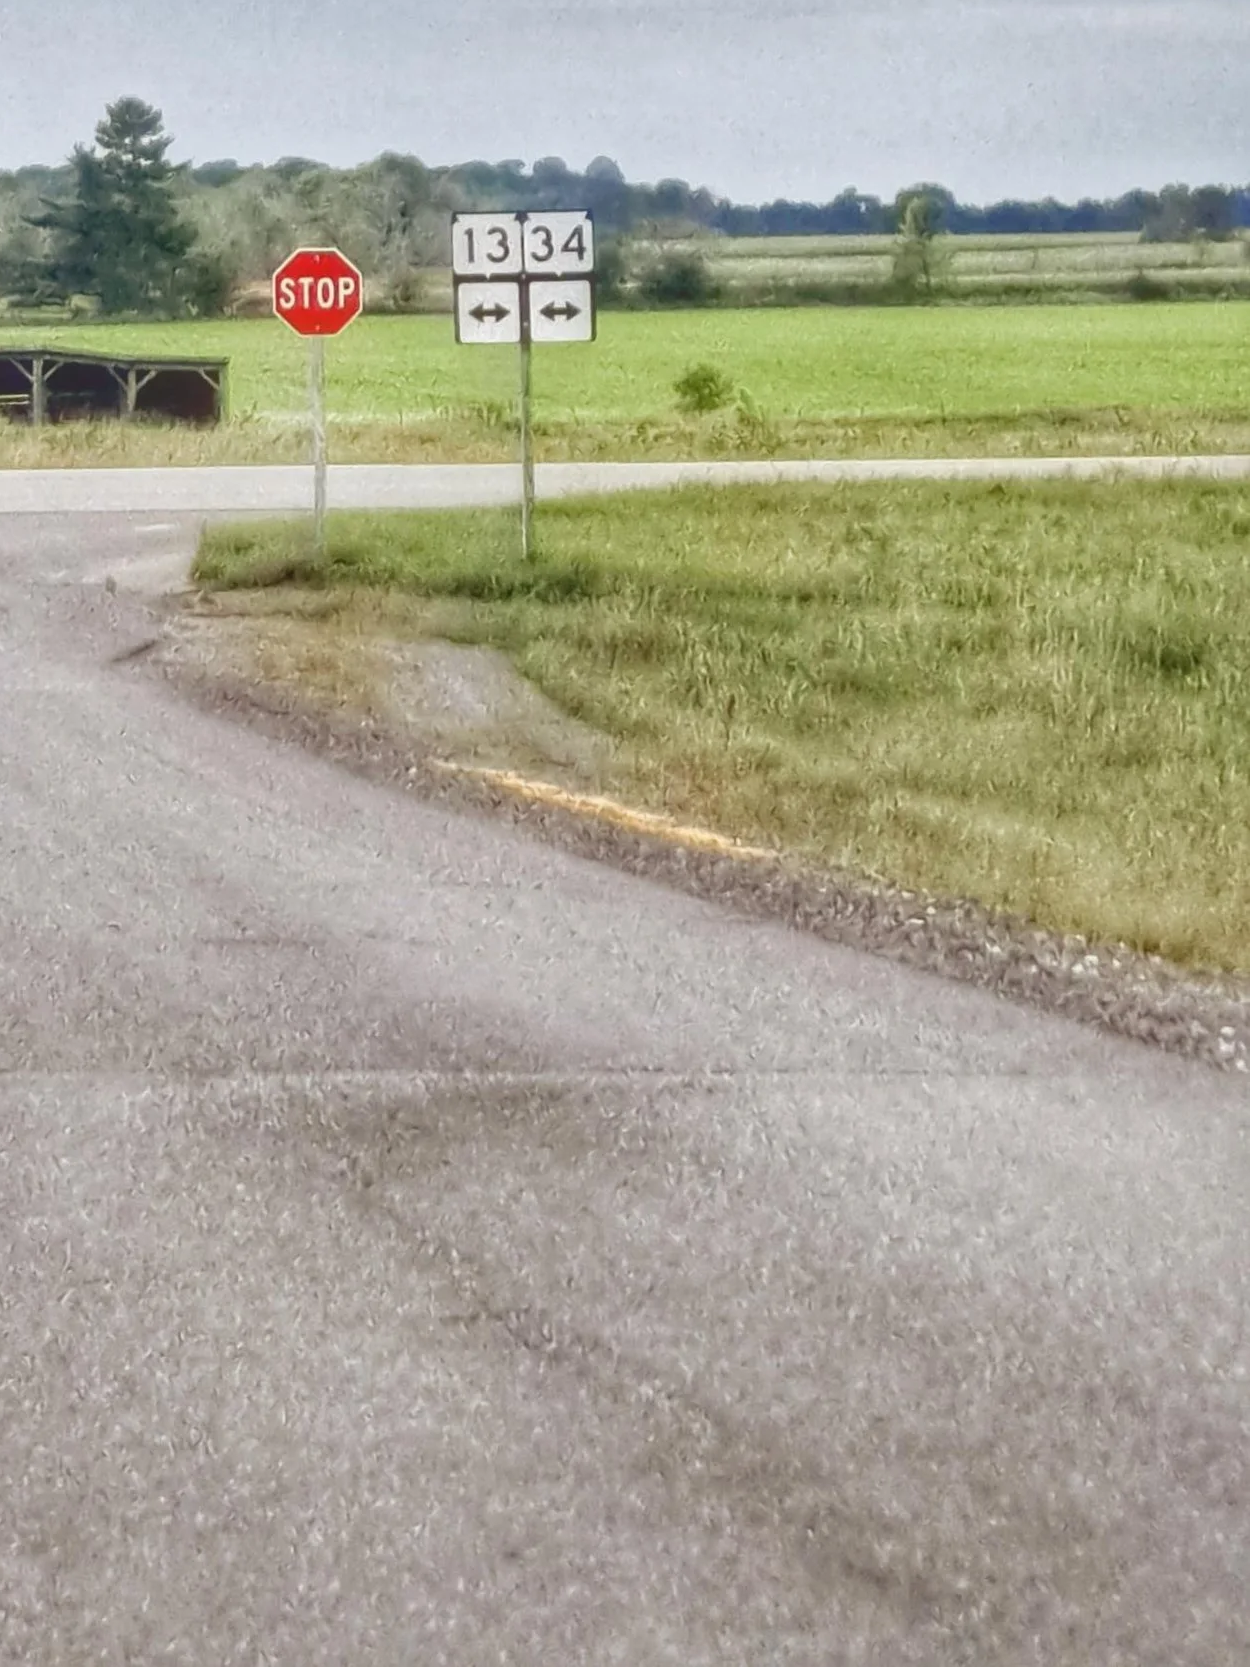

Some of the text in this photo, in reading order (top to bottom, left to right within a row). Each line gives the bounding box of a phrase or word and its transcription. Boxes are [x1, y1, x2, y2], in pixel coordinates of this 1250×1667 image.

[464, 227, 510, 263] 13
[530, 224, 586, 262] 34
[279, 277, 355, 309] STOP
